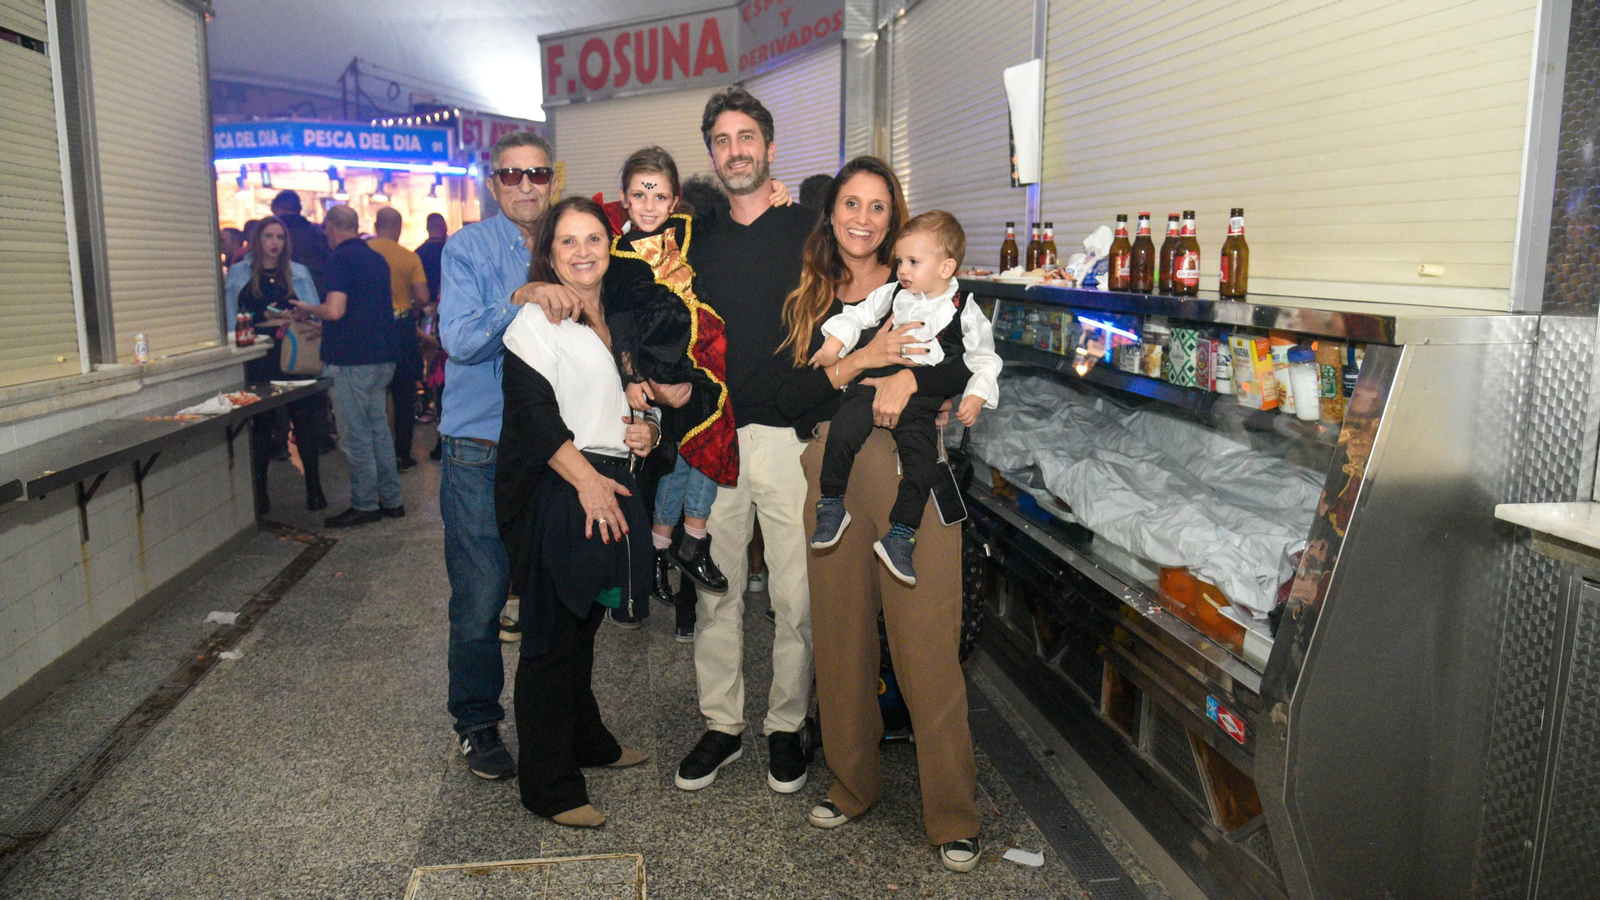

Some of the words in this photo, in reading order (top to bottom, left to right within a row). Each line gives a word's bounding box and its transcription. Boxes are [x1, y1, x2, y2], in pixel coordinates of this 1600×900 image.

[779, 6, 793, 27] Y
[739, 9, 843, 71] DERIVADOS
[235, 130, 257, 148] DEL
[258, 128, 280, 147] DIA
[303, 129, 356, 149] PESCA
[359, 132, 390, 150] DEL
[393, 134, 422, 151] DIA
